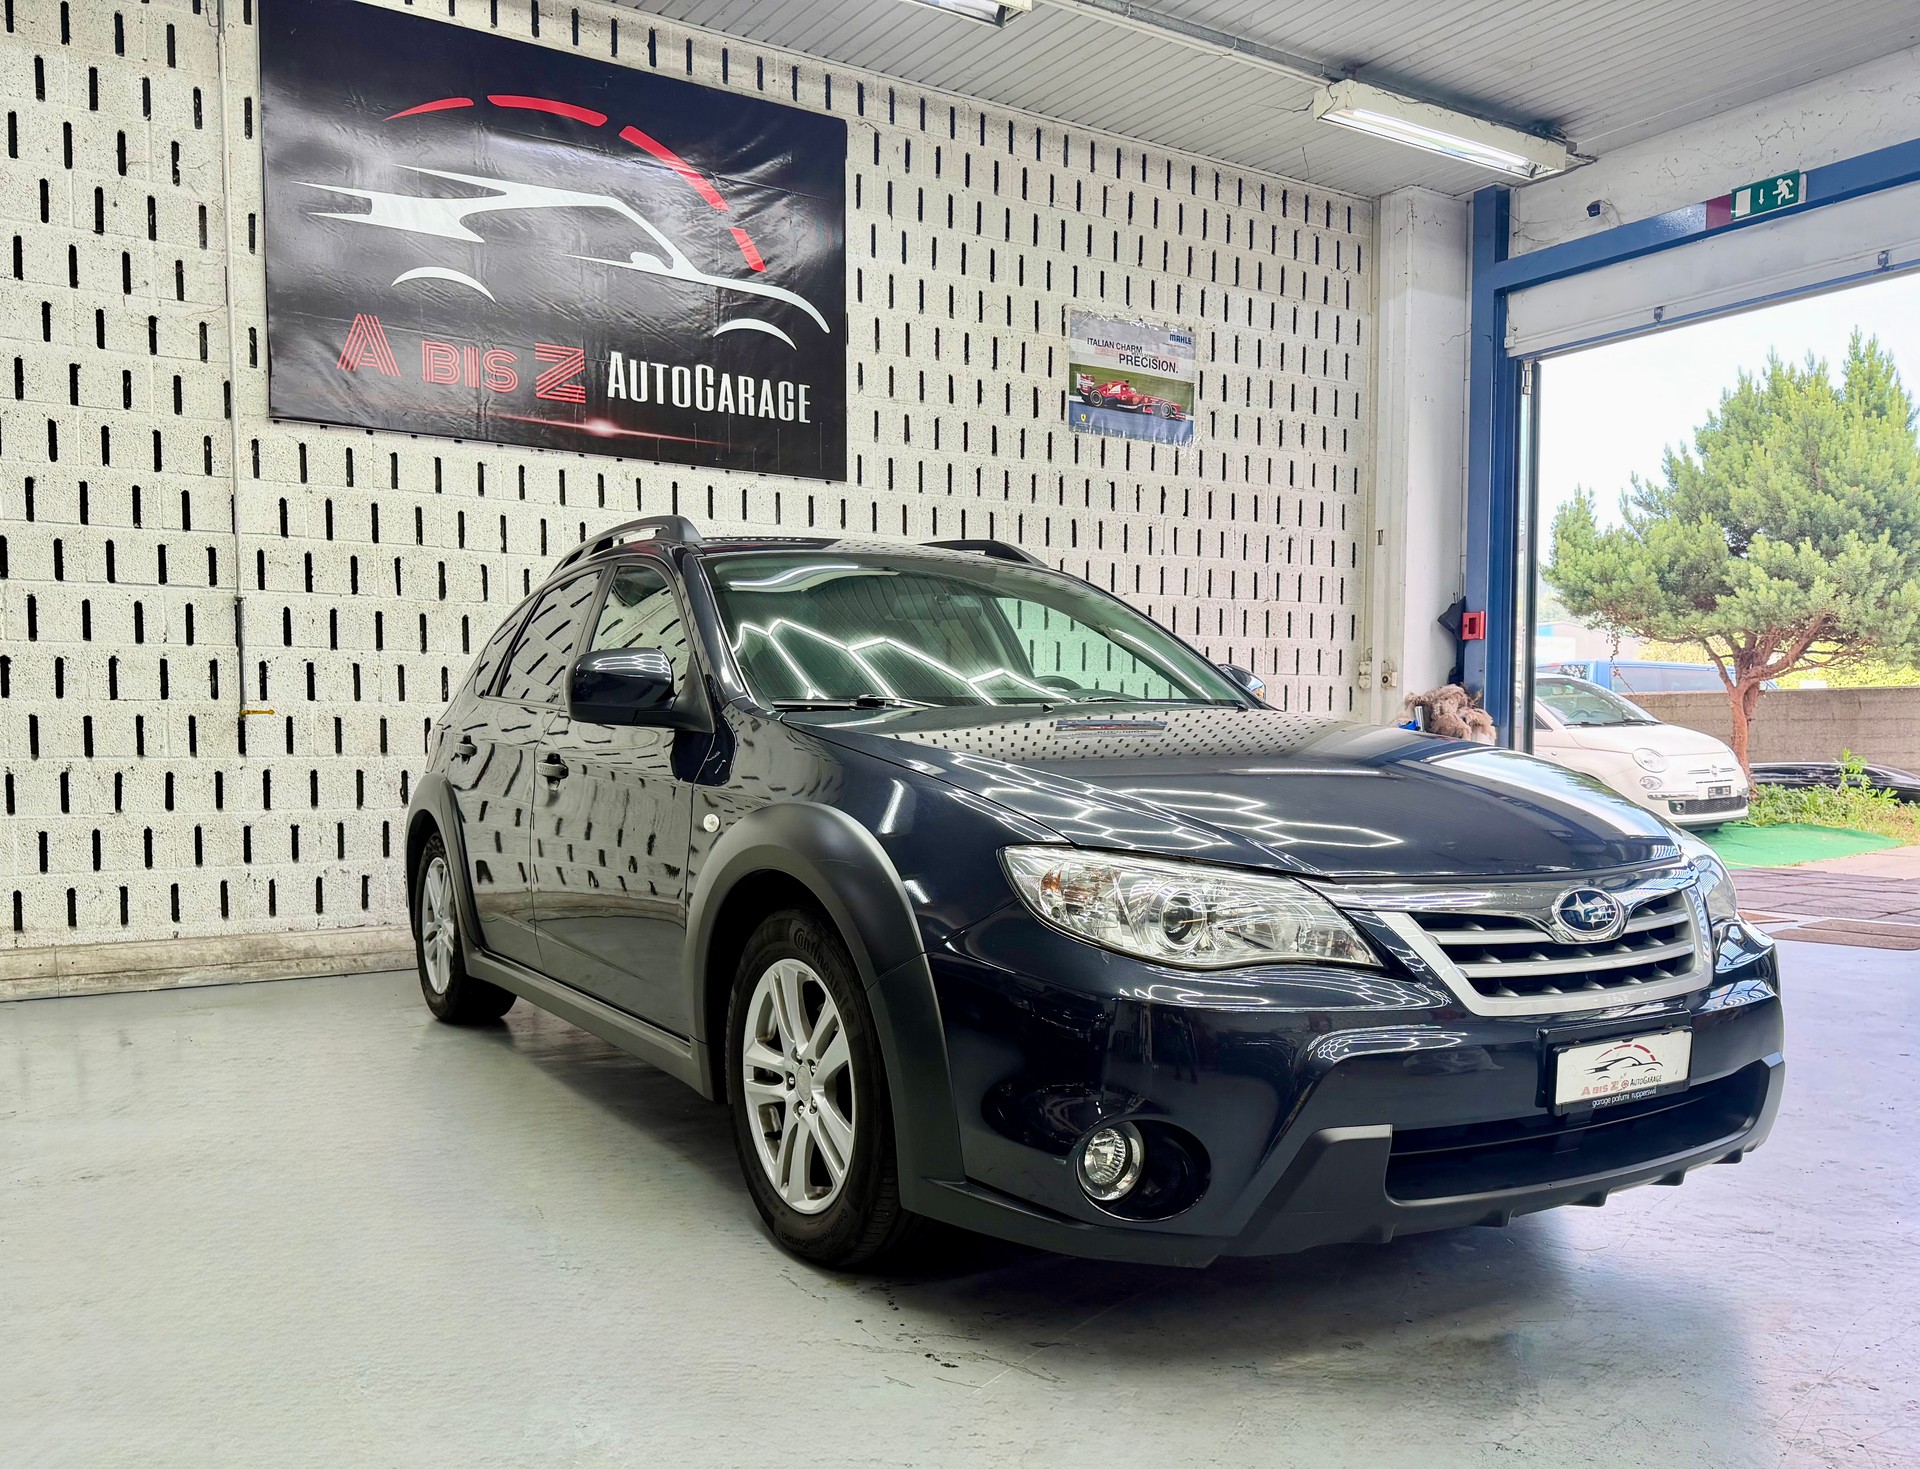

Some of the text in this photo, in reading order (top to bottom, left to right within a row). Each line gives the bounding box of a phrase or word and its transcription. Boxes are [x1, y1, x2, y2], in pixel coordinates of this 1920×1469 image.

[1087, 337, 1143, 353] ITALIAN CHARM
[1169, 333, 1192, 345] MAHLE
[335, 312, 401, 377] A
[421, 340, 520, 393] BIS
[534, 342, 587, 404] Z
[1119, 353, 1179, 374] PRECISION.
[1581, 1086, 1591, 1096] A
[1592, 1084, 1609, 1094] BIS
[1610, 1080, 1620, 1091] Z
[1592, 1096, 1611, 1108] garage
